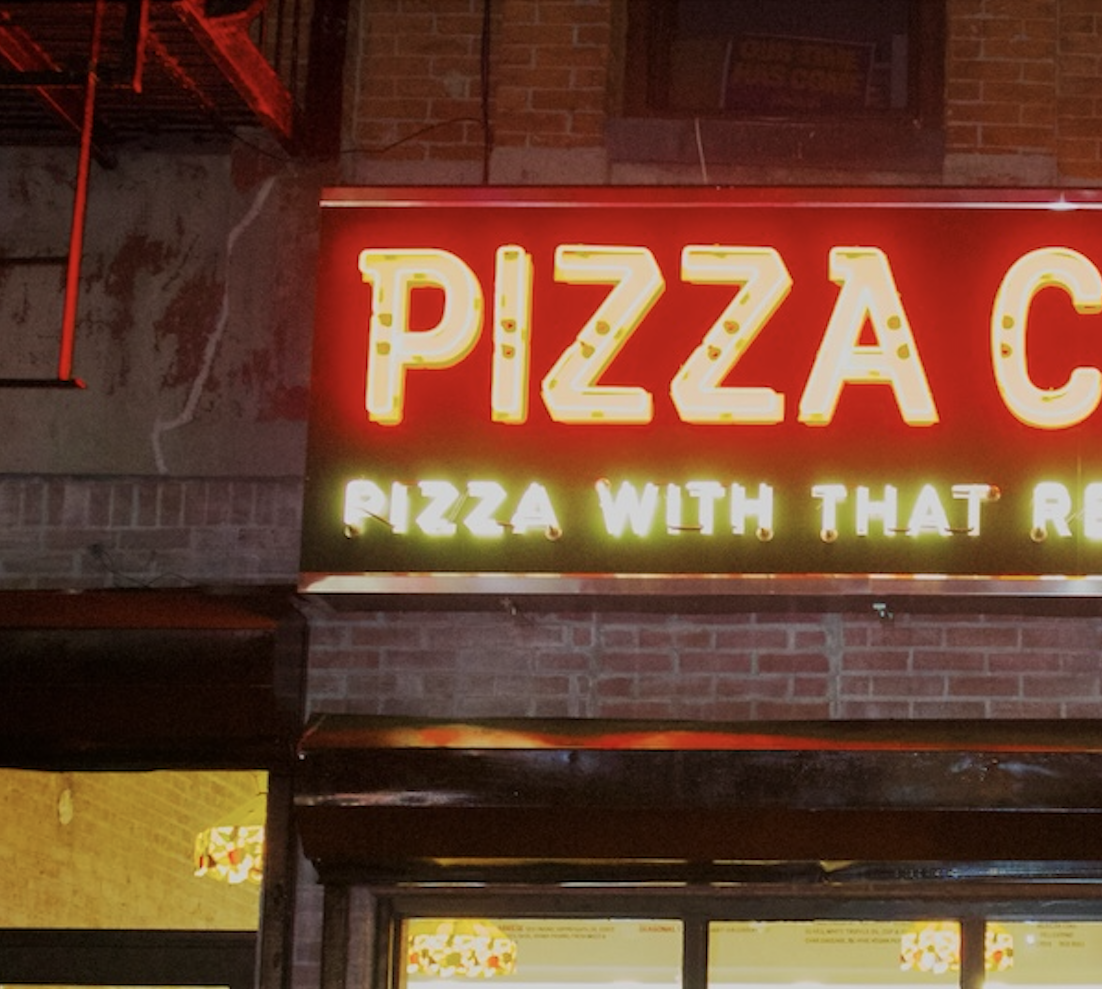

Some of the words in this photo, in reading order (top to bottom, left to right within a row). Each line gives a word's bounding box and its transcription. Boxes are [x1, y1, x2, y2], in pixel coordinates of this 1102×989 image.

[359, 244, 939, 425] PIZZA
[343, 479, 560, 538] PIZZA
[598, 480, 775, 538] WITH
[811, 483, 992, 538] THAT
